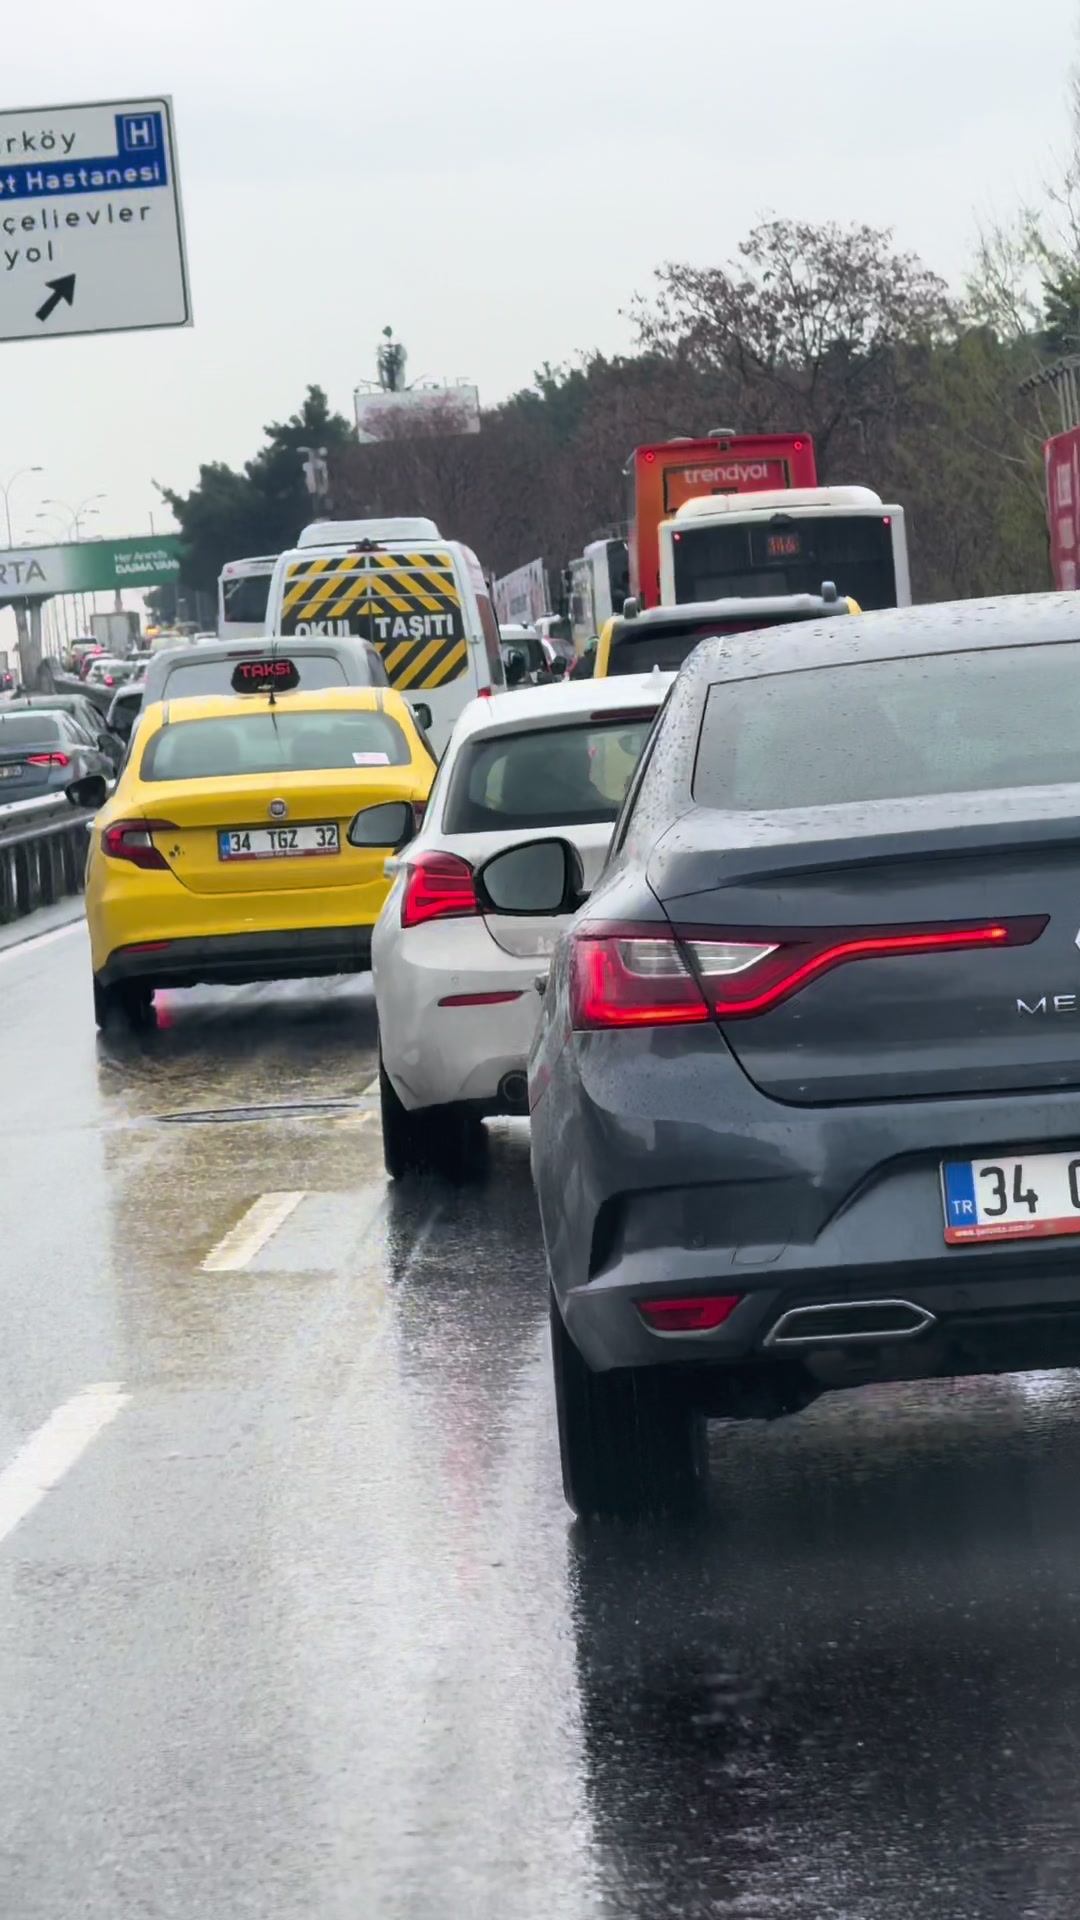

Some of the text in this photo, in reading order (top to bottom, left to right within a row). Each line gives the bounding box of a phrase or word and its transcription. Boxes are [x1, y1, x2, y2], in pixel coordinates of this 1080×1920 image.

[6, 130, 76, 154] rköy
[129, 120, 151, 146] H
[26, 161, 160, 192] Hastanesi
[3, 203, 151, 236] çelievler
[4, 240, 53, 271] yol
[683, 462, 768, 484] trendyol
[374, 613, 454, 642] TAŞITI
[230, 827, 337, 852] 34 TGZ 32
[1016, 994, 1077, 1015] ME
[951, 1199, 974, 1215] TR
[979, 1163, 1039, 1217] 34
